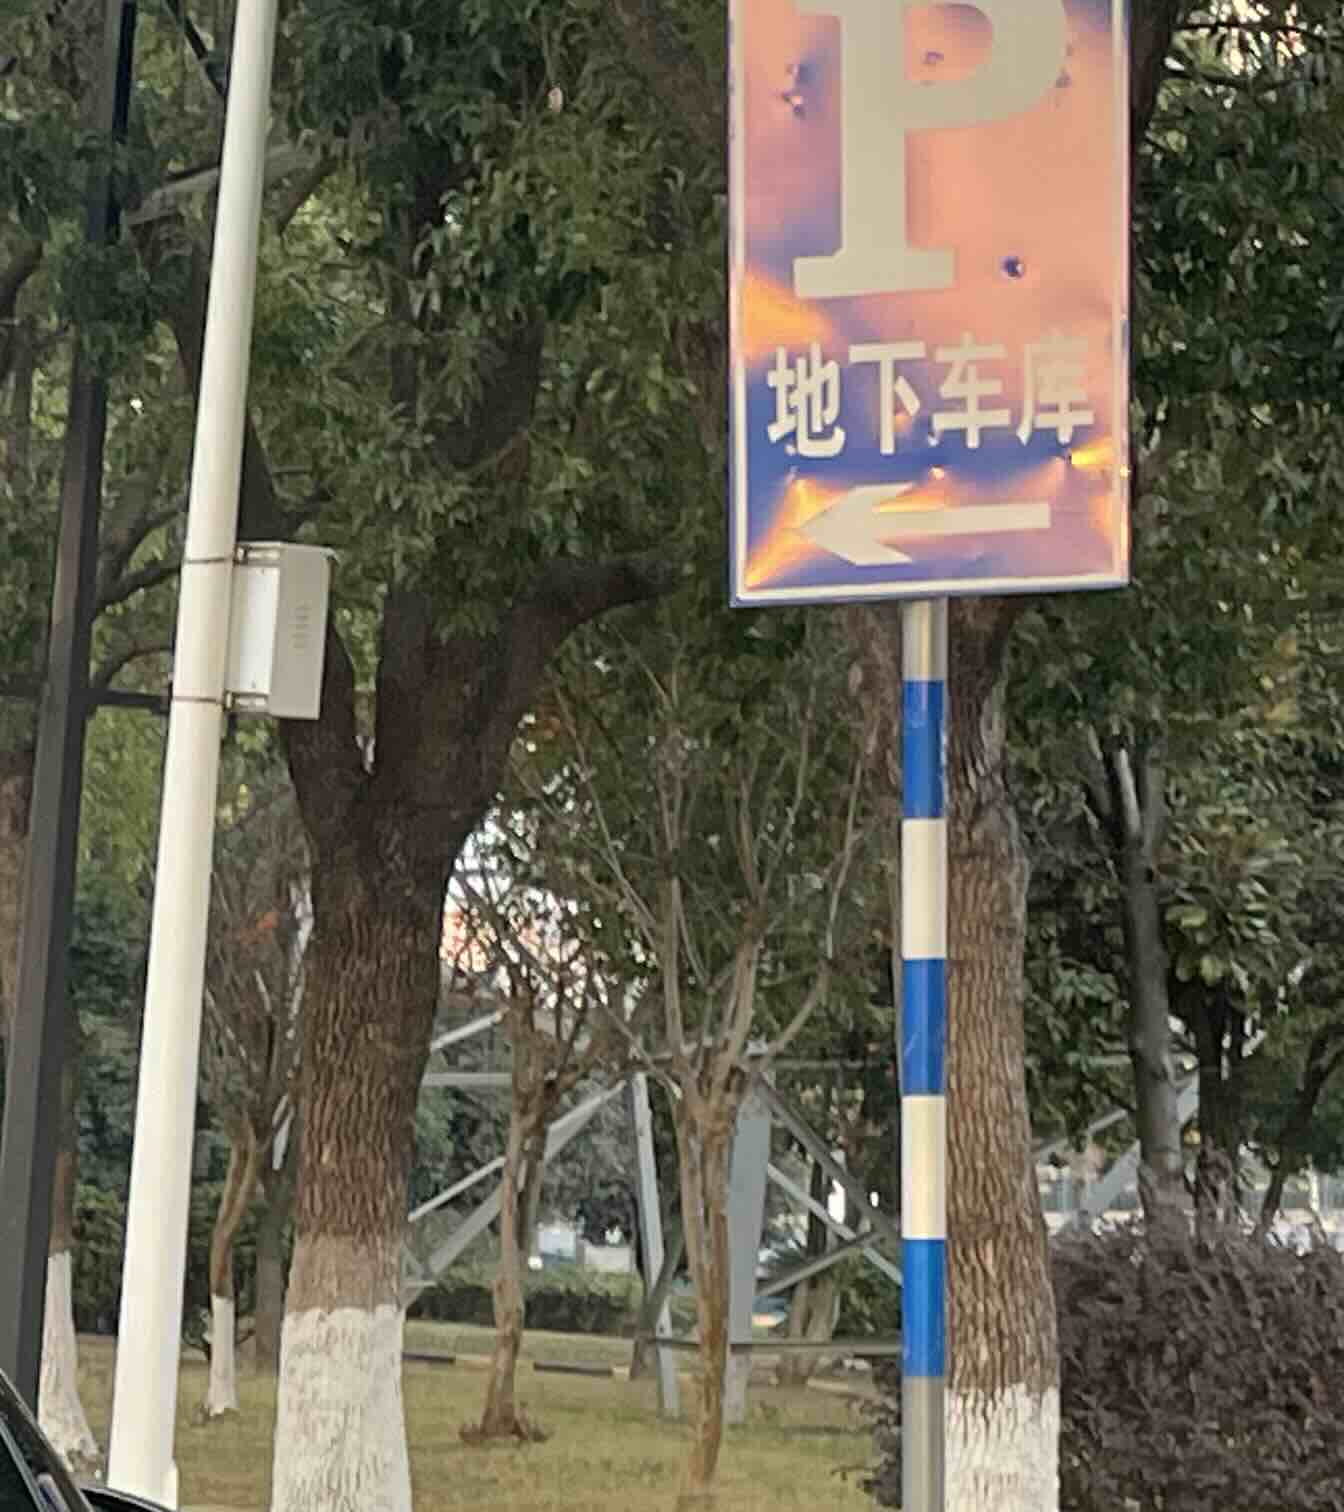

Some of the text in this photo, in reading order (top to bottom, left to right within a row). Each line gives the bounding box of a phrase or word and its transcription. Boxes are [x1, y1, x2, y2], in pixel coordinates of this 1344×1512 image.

[791, 0, 1066, 298] P
[767, 333, 1095, 458] 地下车库
